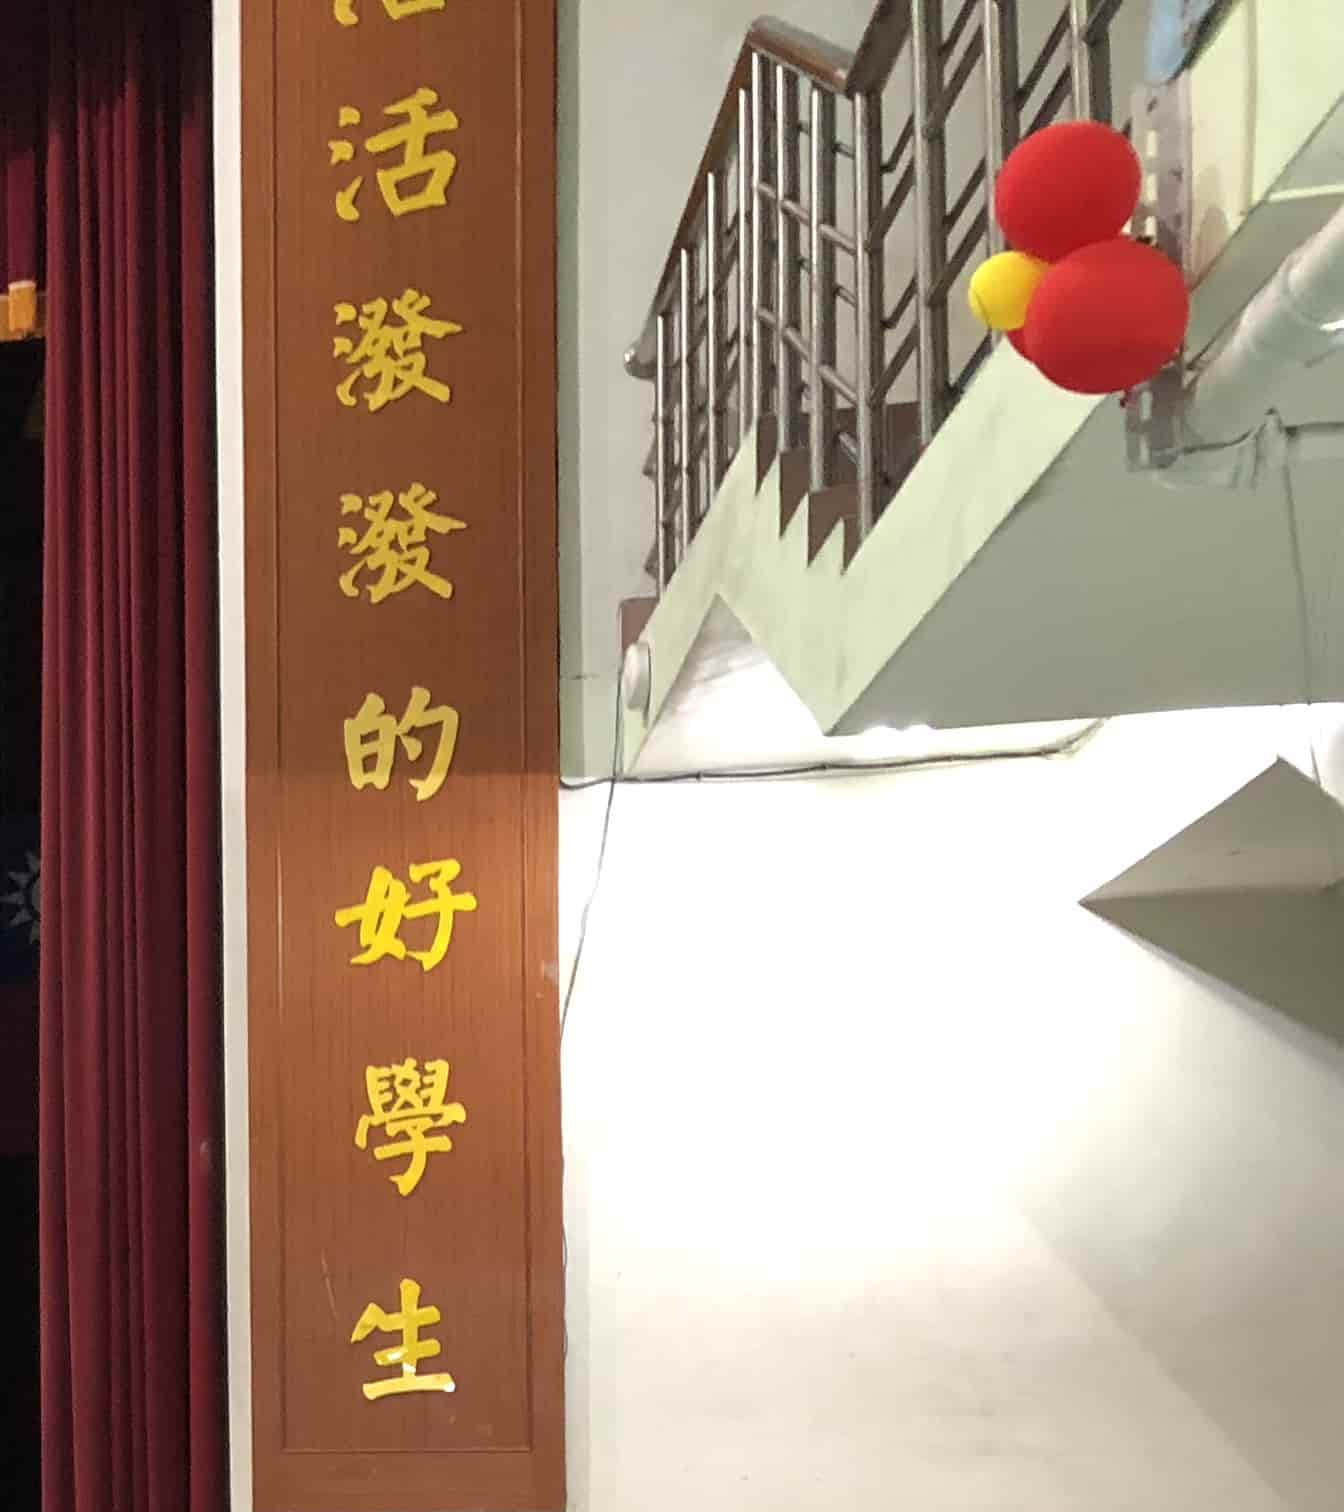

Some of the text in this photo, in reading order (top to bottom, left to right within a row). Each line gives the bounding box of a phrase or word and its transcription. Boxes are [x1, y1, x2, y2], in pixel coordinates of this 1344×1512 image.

[327, 0, 478, 1401] 活潑潑的好學生
